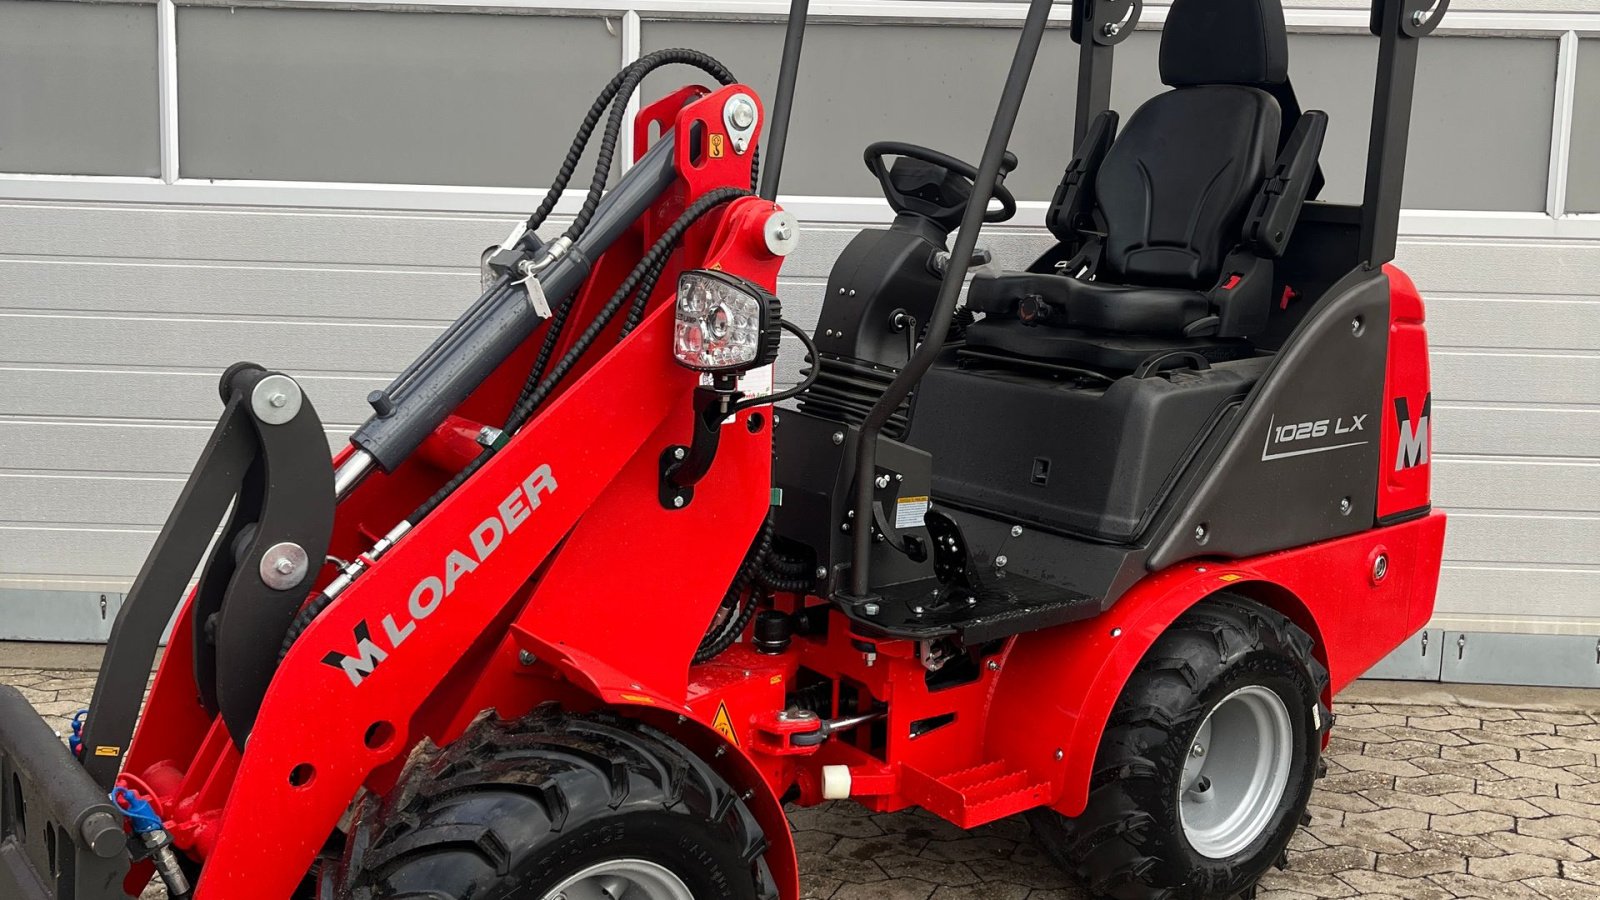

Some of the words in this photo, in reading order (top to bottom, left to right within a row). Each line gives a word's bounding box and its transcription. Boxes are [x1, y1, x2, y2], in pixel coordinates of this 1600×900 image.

[1274, 419, 1330, 444] 1026
[1334, 413, 1369, 435] LX
[381, 463, 559, 649] LOADER
